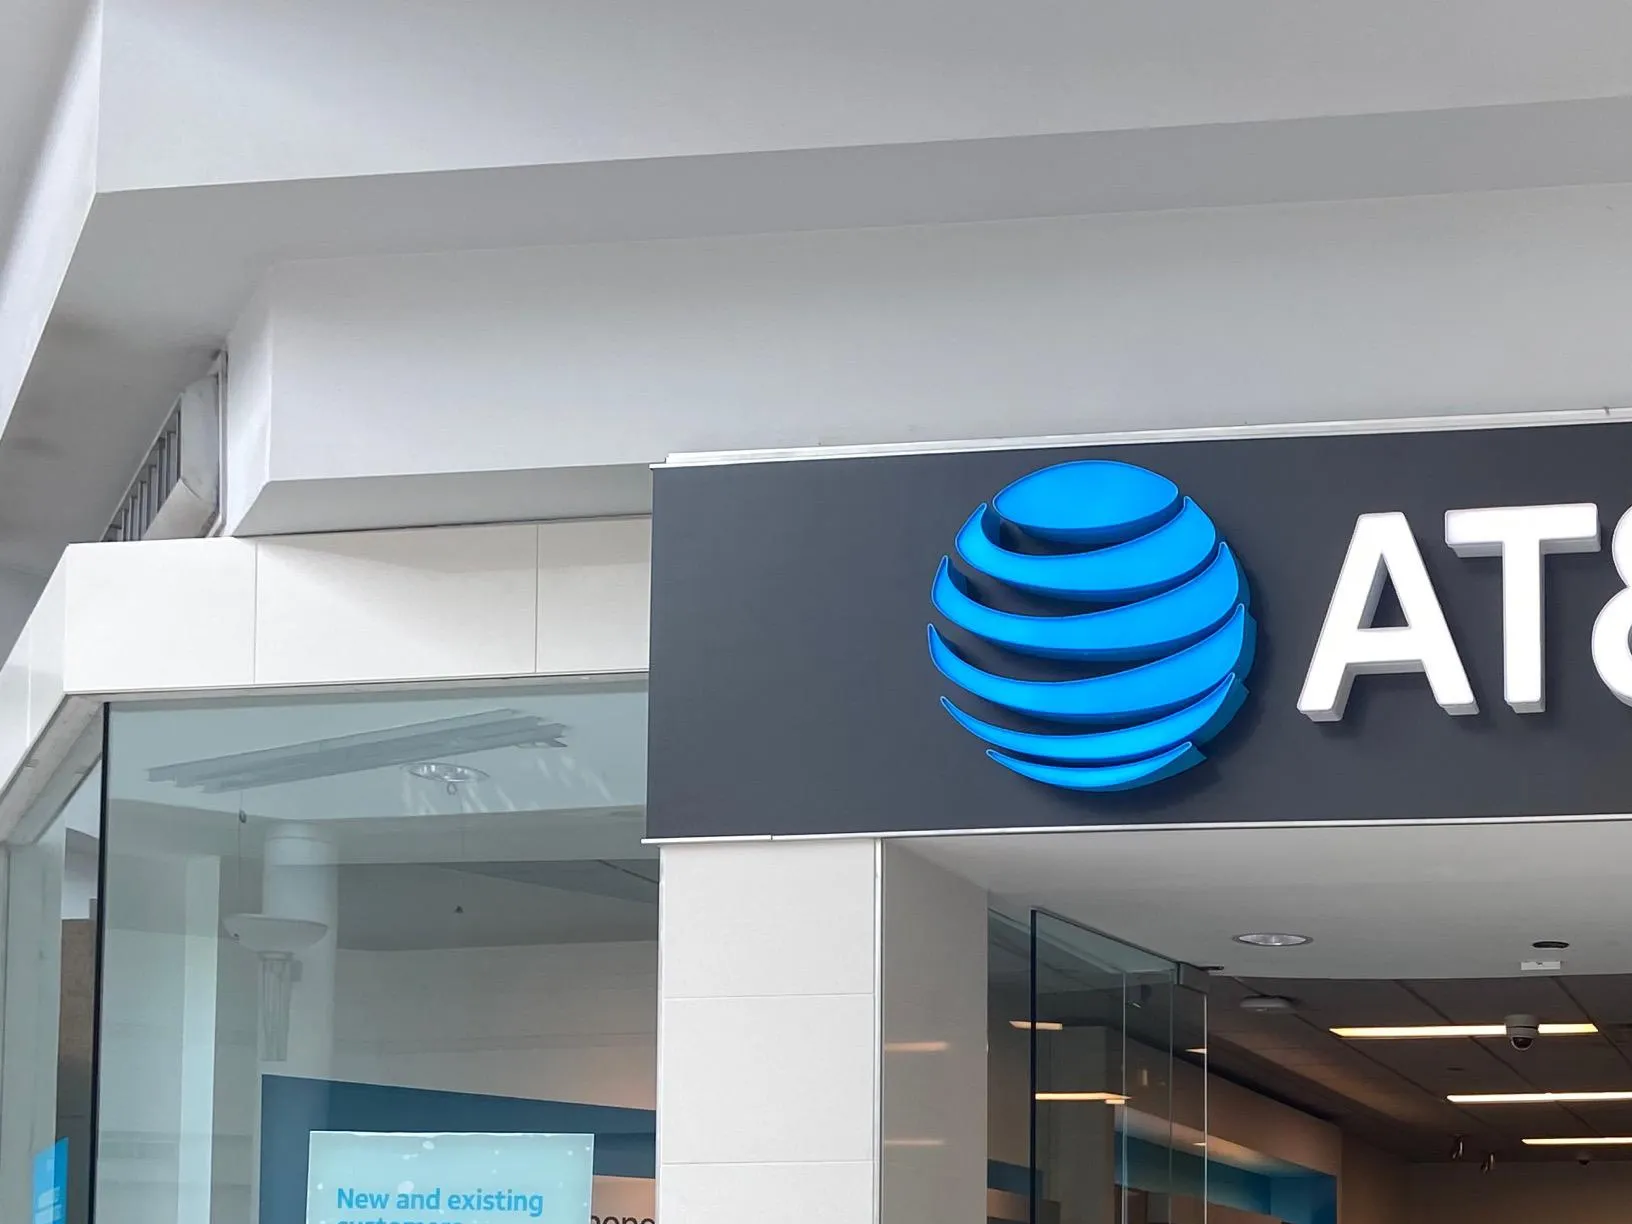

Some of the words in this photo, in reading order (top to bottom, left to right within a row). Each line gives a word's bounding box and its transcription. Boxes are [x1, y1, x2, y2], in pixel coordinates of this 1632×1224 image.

[337, 1188, 390, 1209] New
[396, 1188, 441, 1211] and
[447, 1188, 544, 1217] existing
